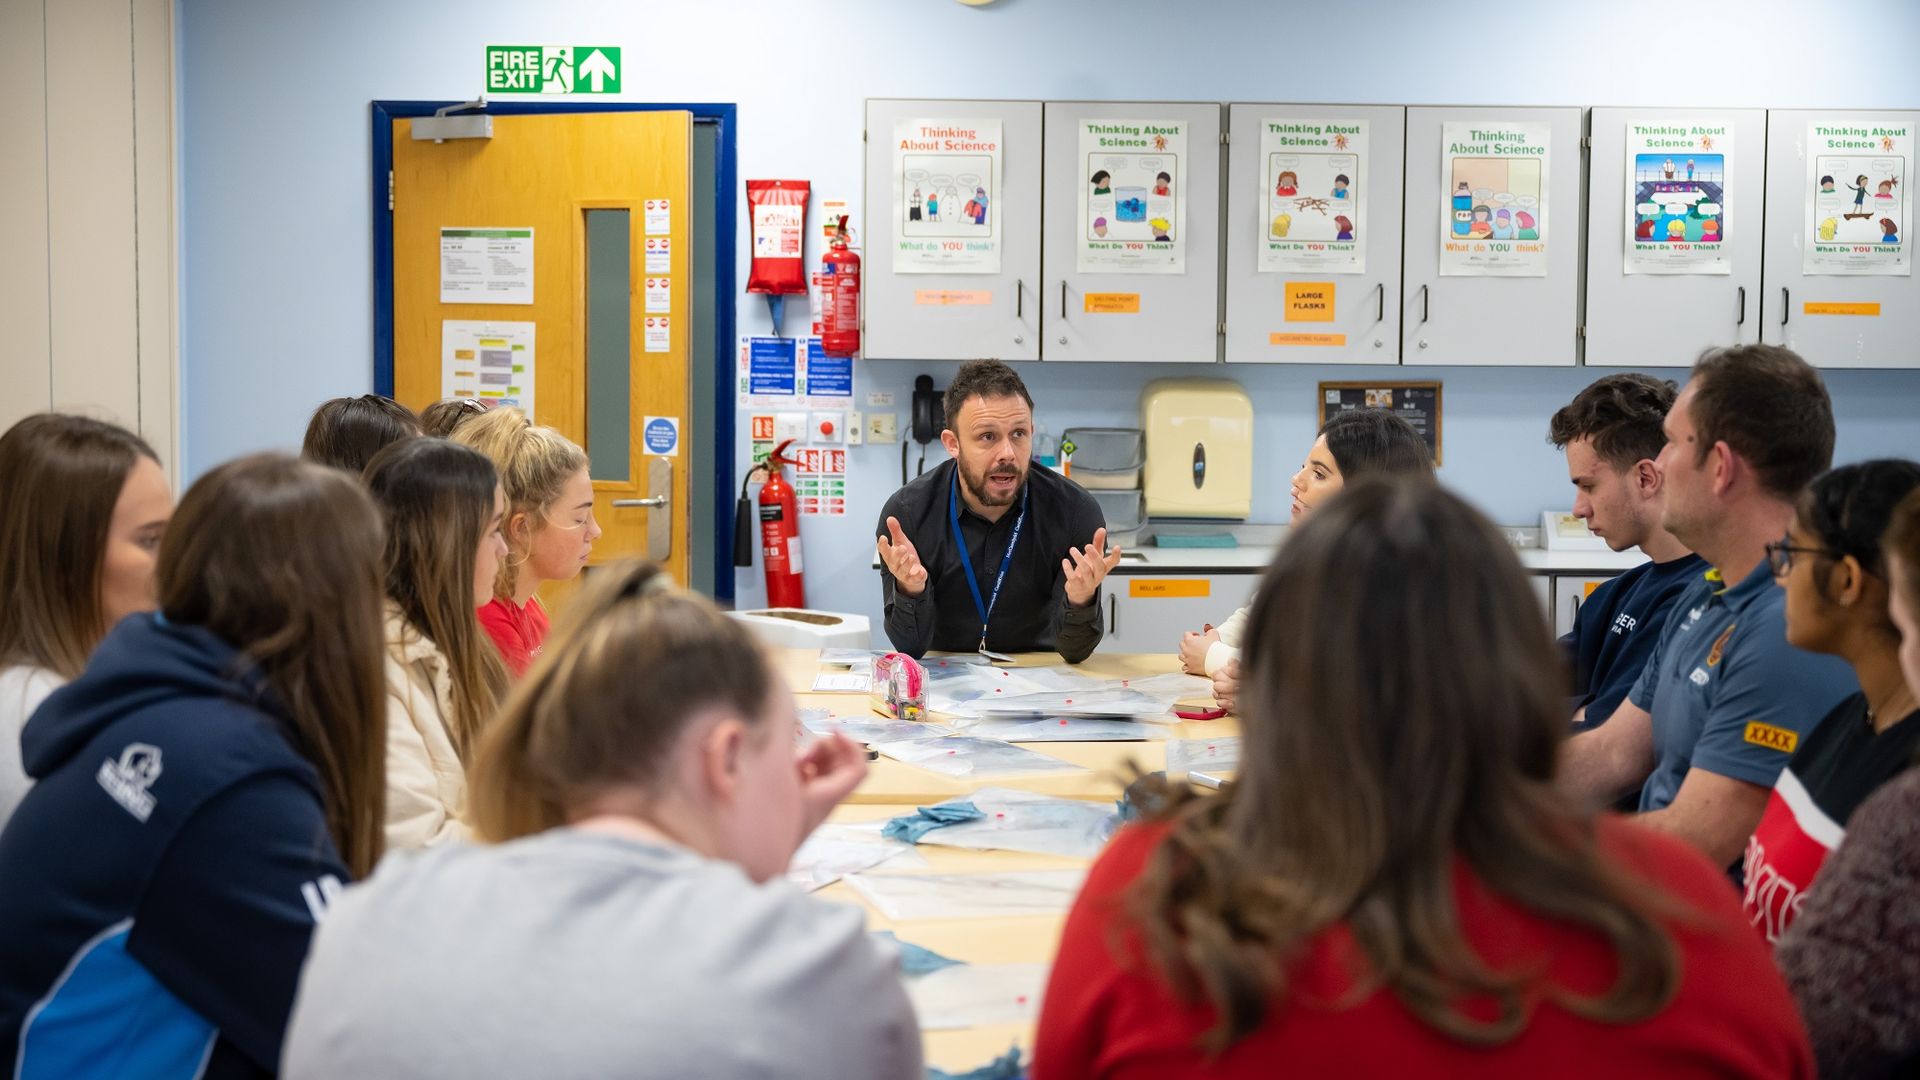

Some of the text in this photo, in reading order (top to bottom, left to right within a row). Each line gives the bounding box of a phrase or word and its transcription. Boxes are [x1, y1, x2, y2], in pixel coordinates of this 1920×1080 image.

[490, 51, 539, 69] FIRE
[490, 70, 539, 88] EXIT
[920, 127, 976, 139] Thinking
[1087, 125, 1179, 135] Thinking About
[1269, 124, 1360, 135] Thinking About
[1634, 126, 1726, 136] Thinking About
[1815, 127, 1906, 137] Thinking About
[1280, 136, 1328, 146] Science
[1469, 130, 1526, 143] Thinking
[900, 140, 996, 151] About Science
[1099, 137, 1147, 147] Science
[1646, 138, 1694, 148] Science
[1827, 139, 1875, 148] Science
[1449, 143, 1545, 154] About Science
[899, 241, 995, 250] What do YOU think?
[1445, 243, 1545, 252] What do YOU think?
[1293, 302, 1326, 310] FLASKS
[1749, 726, 1792, 749] XXXX
